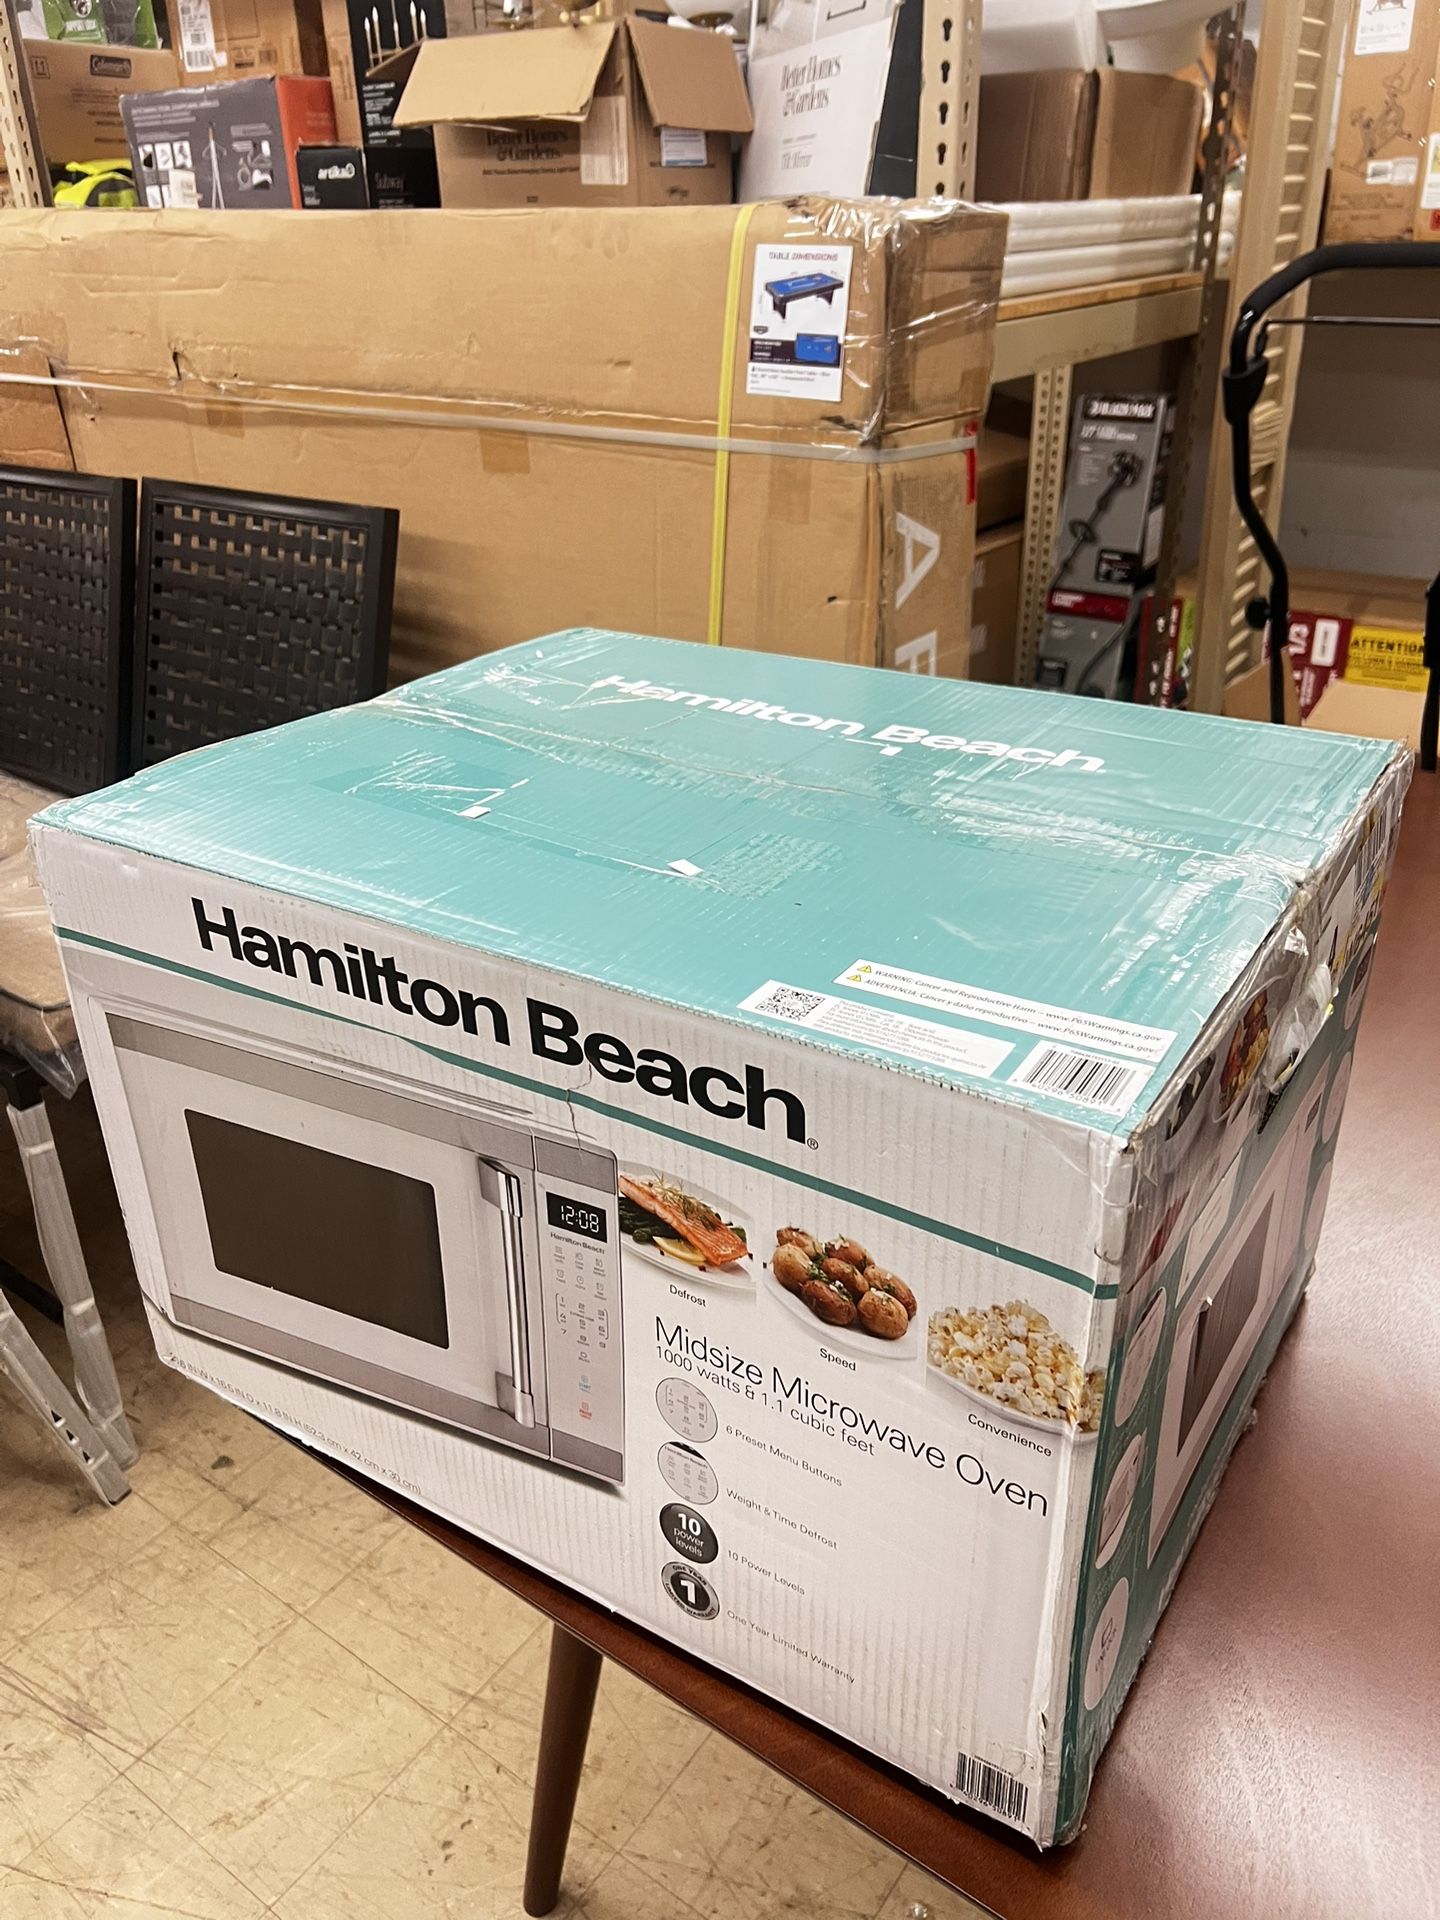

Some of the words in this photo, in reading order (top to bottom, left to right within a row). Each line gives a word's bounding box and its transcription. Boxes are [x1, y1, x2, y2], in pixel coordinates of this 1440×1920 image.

[600, 675, 865, 734] Hamilton
[870, 724, 1105, 772] Beach
[191, 896, 511, 1047] Hamilton
[875, 970, 914, 984] WARNING:
[915, 980, 941, 991] Cancer
[941, 986, 959, 995] and
[958, 990, 1012, 1008] Reproductive
[1012, 1004, 1036, 1014] Harm
[864, 979, 919, 998] ADVERTENCIA:
[974, 1006, 1028, 1024] reproductivo
[560, 1205, 599, 1233] 12:08
[550, 1232, 582, 1247] Hamilton
[582, 1242, 605, 1254] Beach
[669, 1284, 707, 1308] Defrost
[819, 1347, 857, 1371] Speed
[655, 1315, 764, 1386] Midsize
[772, 1366, 946, 1469] Microwave
[956, 1453, 1048, 1517] Oven
[656, 1345, 693, 1372] 1000
[696, 1365, 741, 1395] watts
[745, 1384, 756, 1400] &
[761, 1392, 784, 1413] 1.1
[790, 1408, 836, 1438] cubic
[841, 1427, 875, 1456] feet
[726, 1425, 733, 1436] 6
[735, 1429, 768, 1451] Preset
[769, 1445, 799, 1466] Menu
[802, 1460, 843, 1487] Buttons
[968, 1413, 1053, 1457] Convenience
[673, 1527, 704, 1548] power
[678, 1513, 702, 1537] 10
[726, 1486, 763, 1514] Weight
[763, 1508, 771, 1517] &
[772, 1510, 797, 1530] Time
[799, 1524, 838, 1550] Defrost
[675, 1536, 703, 1557] levels
[680, 1579, 697, 1605] 1
[728, 1550, 739, 1562] 10
[741, 1556, 772, 1578] Power
[774, 1572, 806, 1596] Levels
[727, 1609, 748, 1626] One
[748, 1621, 771, 1639] Year
[772, 1632, 808, 1659] Limited
[810, 1654, 855, 1685] Warranty
